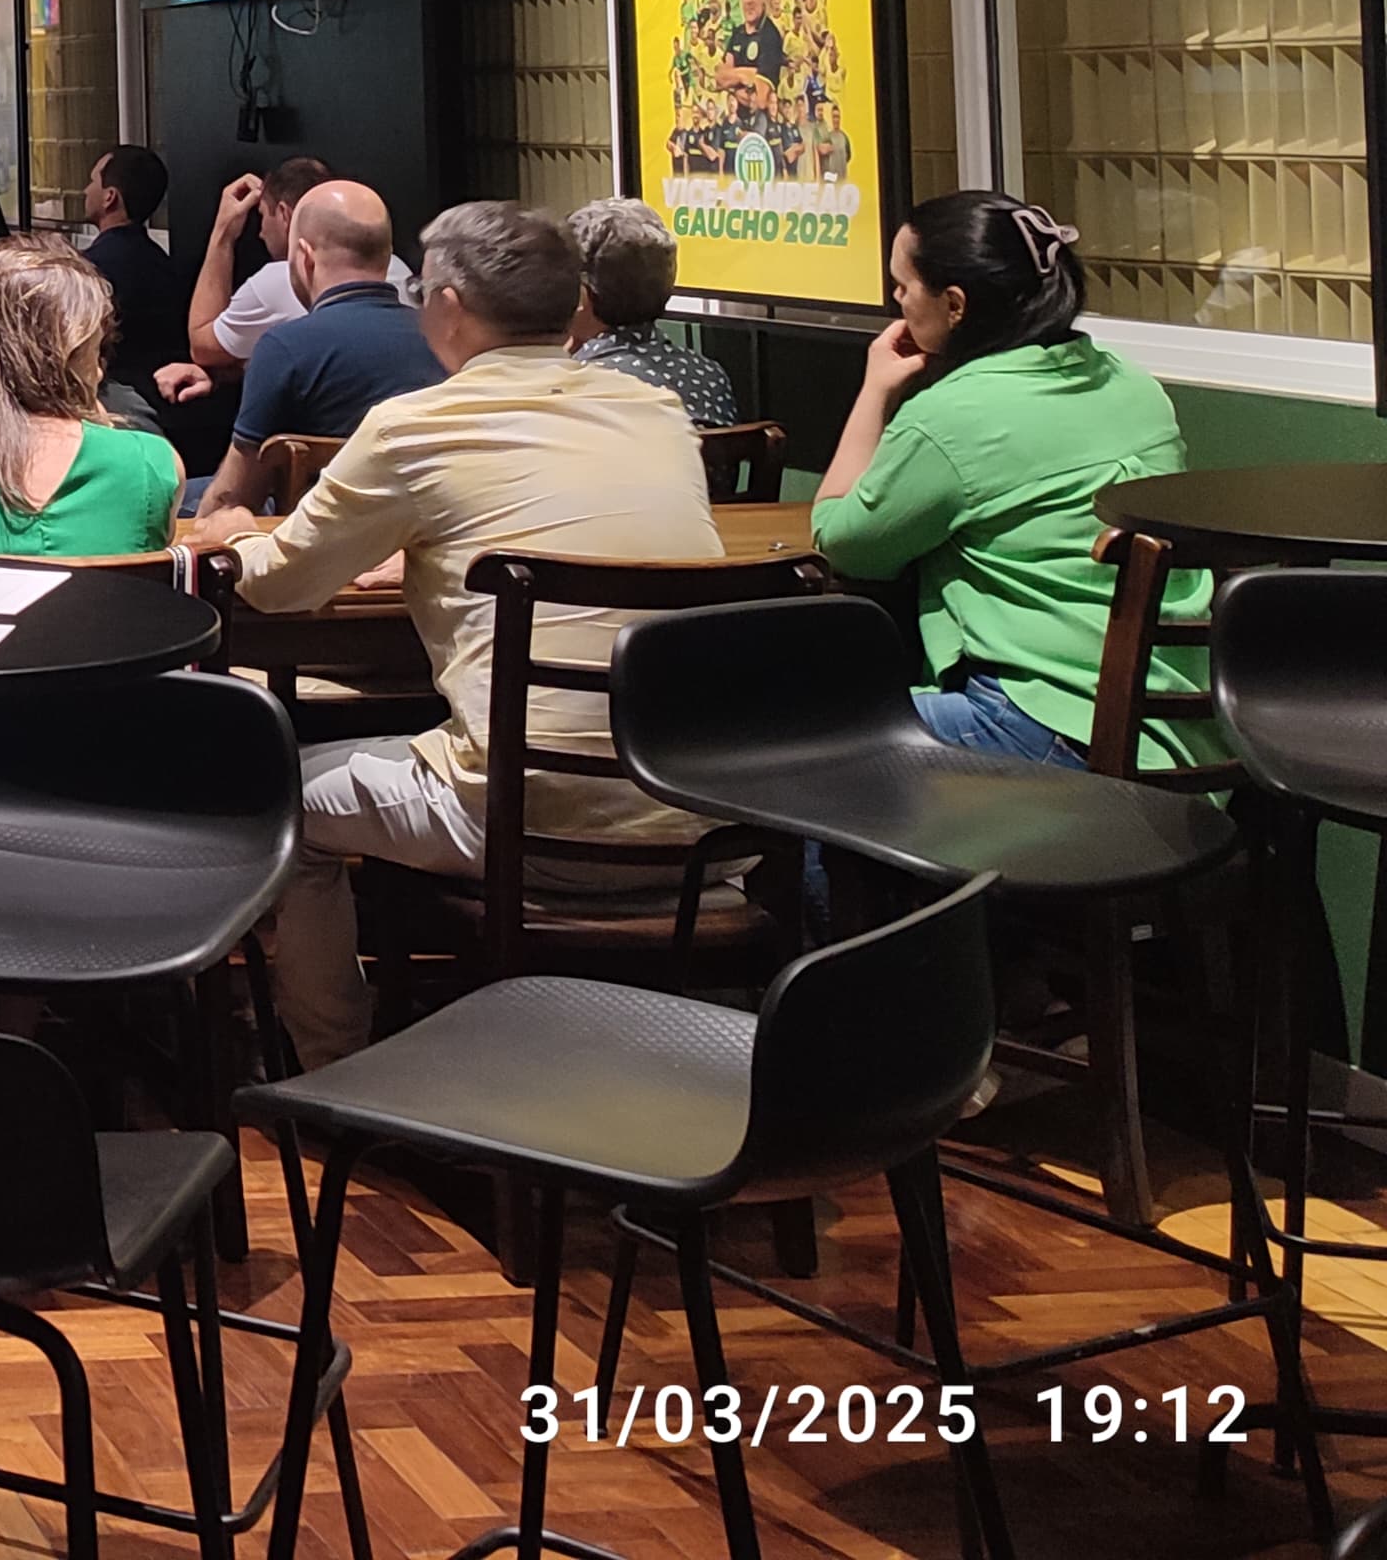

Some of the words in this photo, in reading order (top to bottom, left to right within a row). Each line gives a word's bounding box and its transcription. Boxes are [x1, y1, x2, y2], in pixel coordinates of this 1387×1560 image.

[662, 171, 860, 217] VICE-CAMPEÃO
[672, 199, 780, 243] GAÚCHO
[783, 211, 849, 247] 2022
